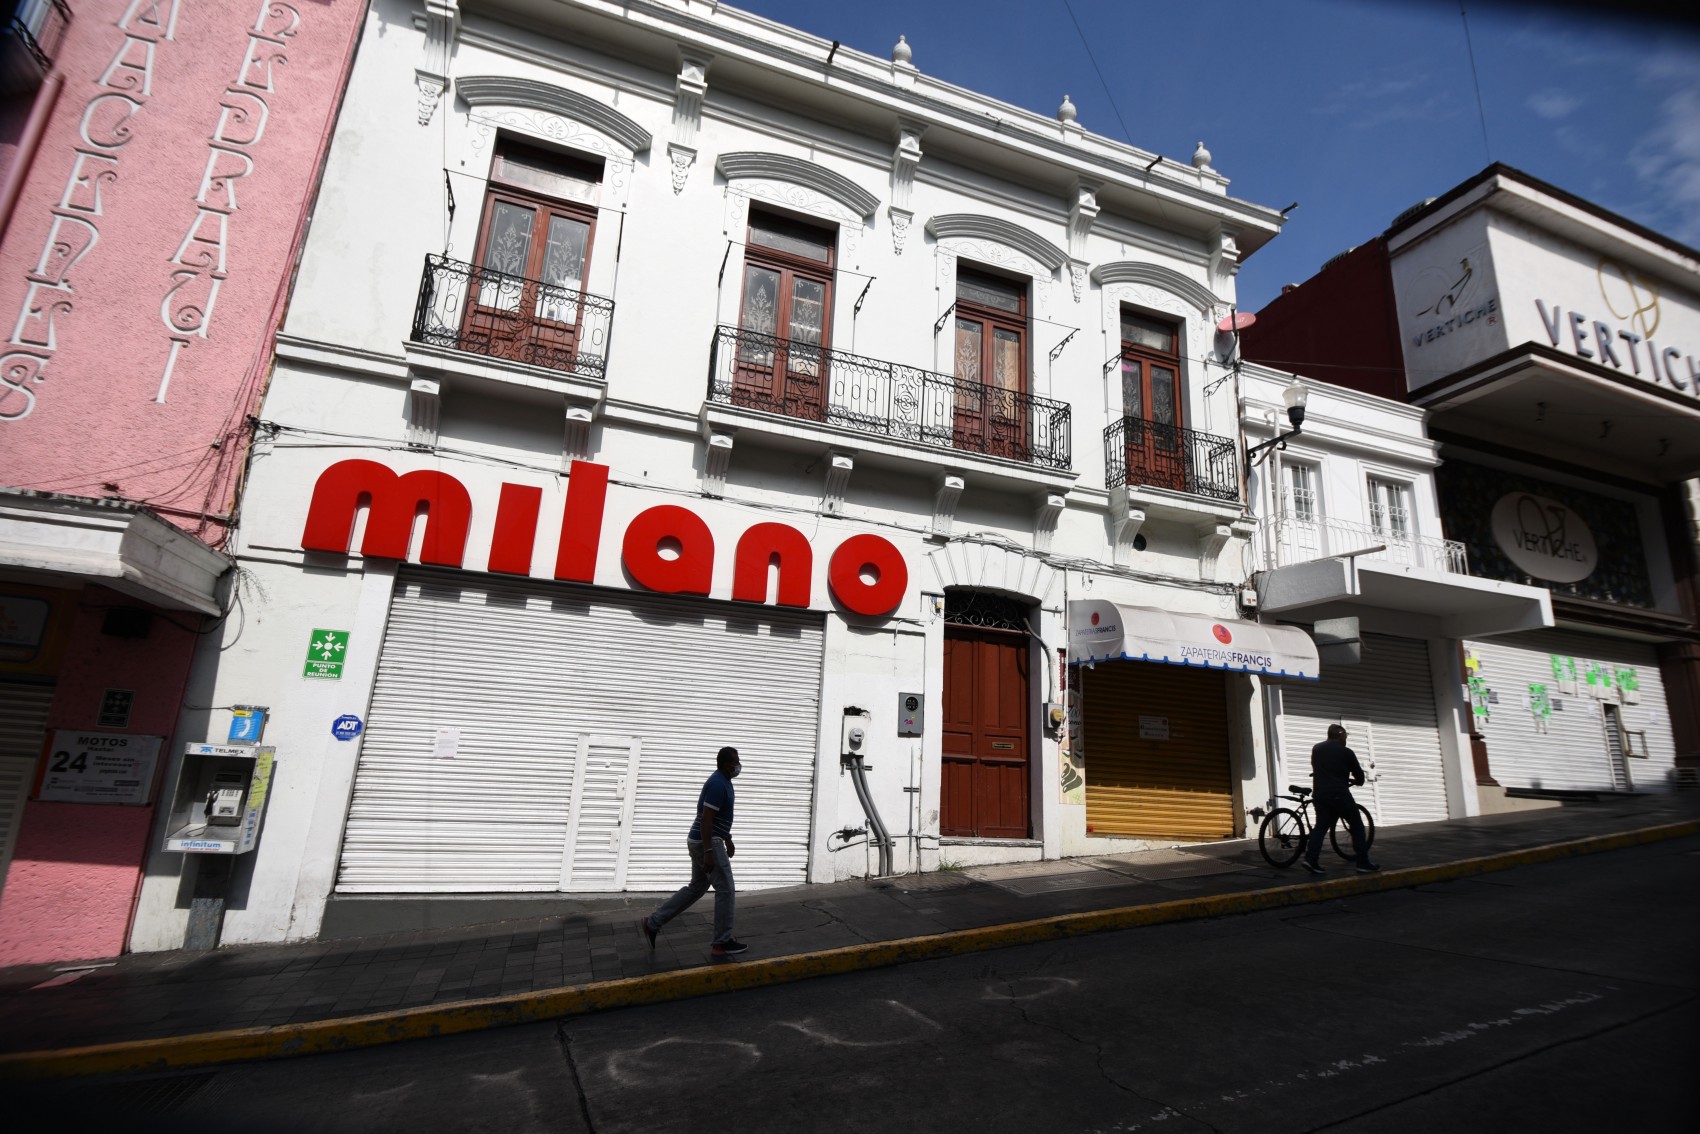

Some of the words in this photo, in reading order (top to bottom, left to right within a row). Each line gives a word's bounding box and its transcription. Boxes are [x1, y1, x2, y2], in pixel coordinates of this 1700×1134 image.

[1413, 298, 1498, 347] VERTICHE
[301, 459, 908, 616] milano
[1513, 529, 1582, 562] VERTICHE
[336, 720, 359, 731] ADT
[78, 736, 128, 747] MOTOS
[214, 747, 245, 755] TELMEX
[49, 750, 88, 774] 24
[180, 840, 221, 849] infinitum
